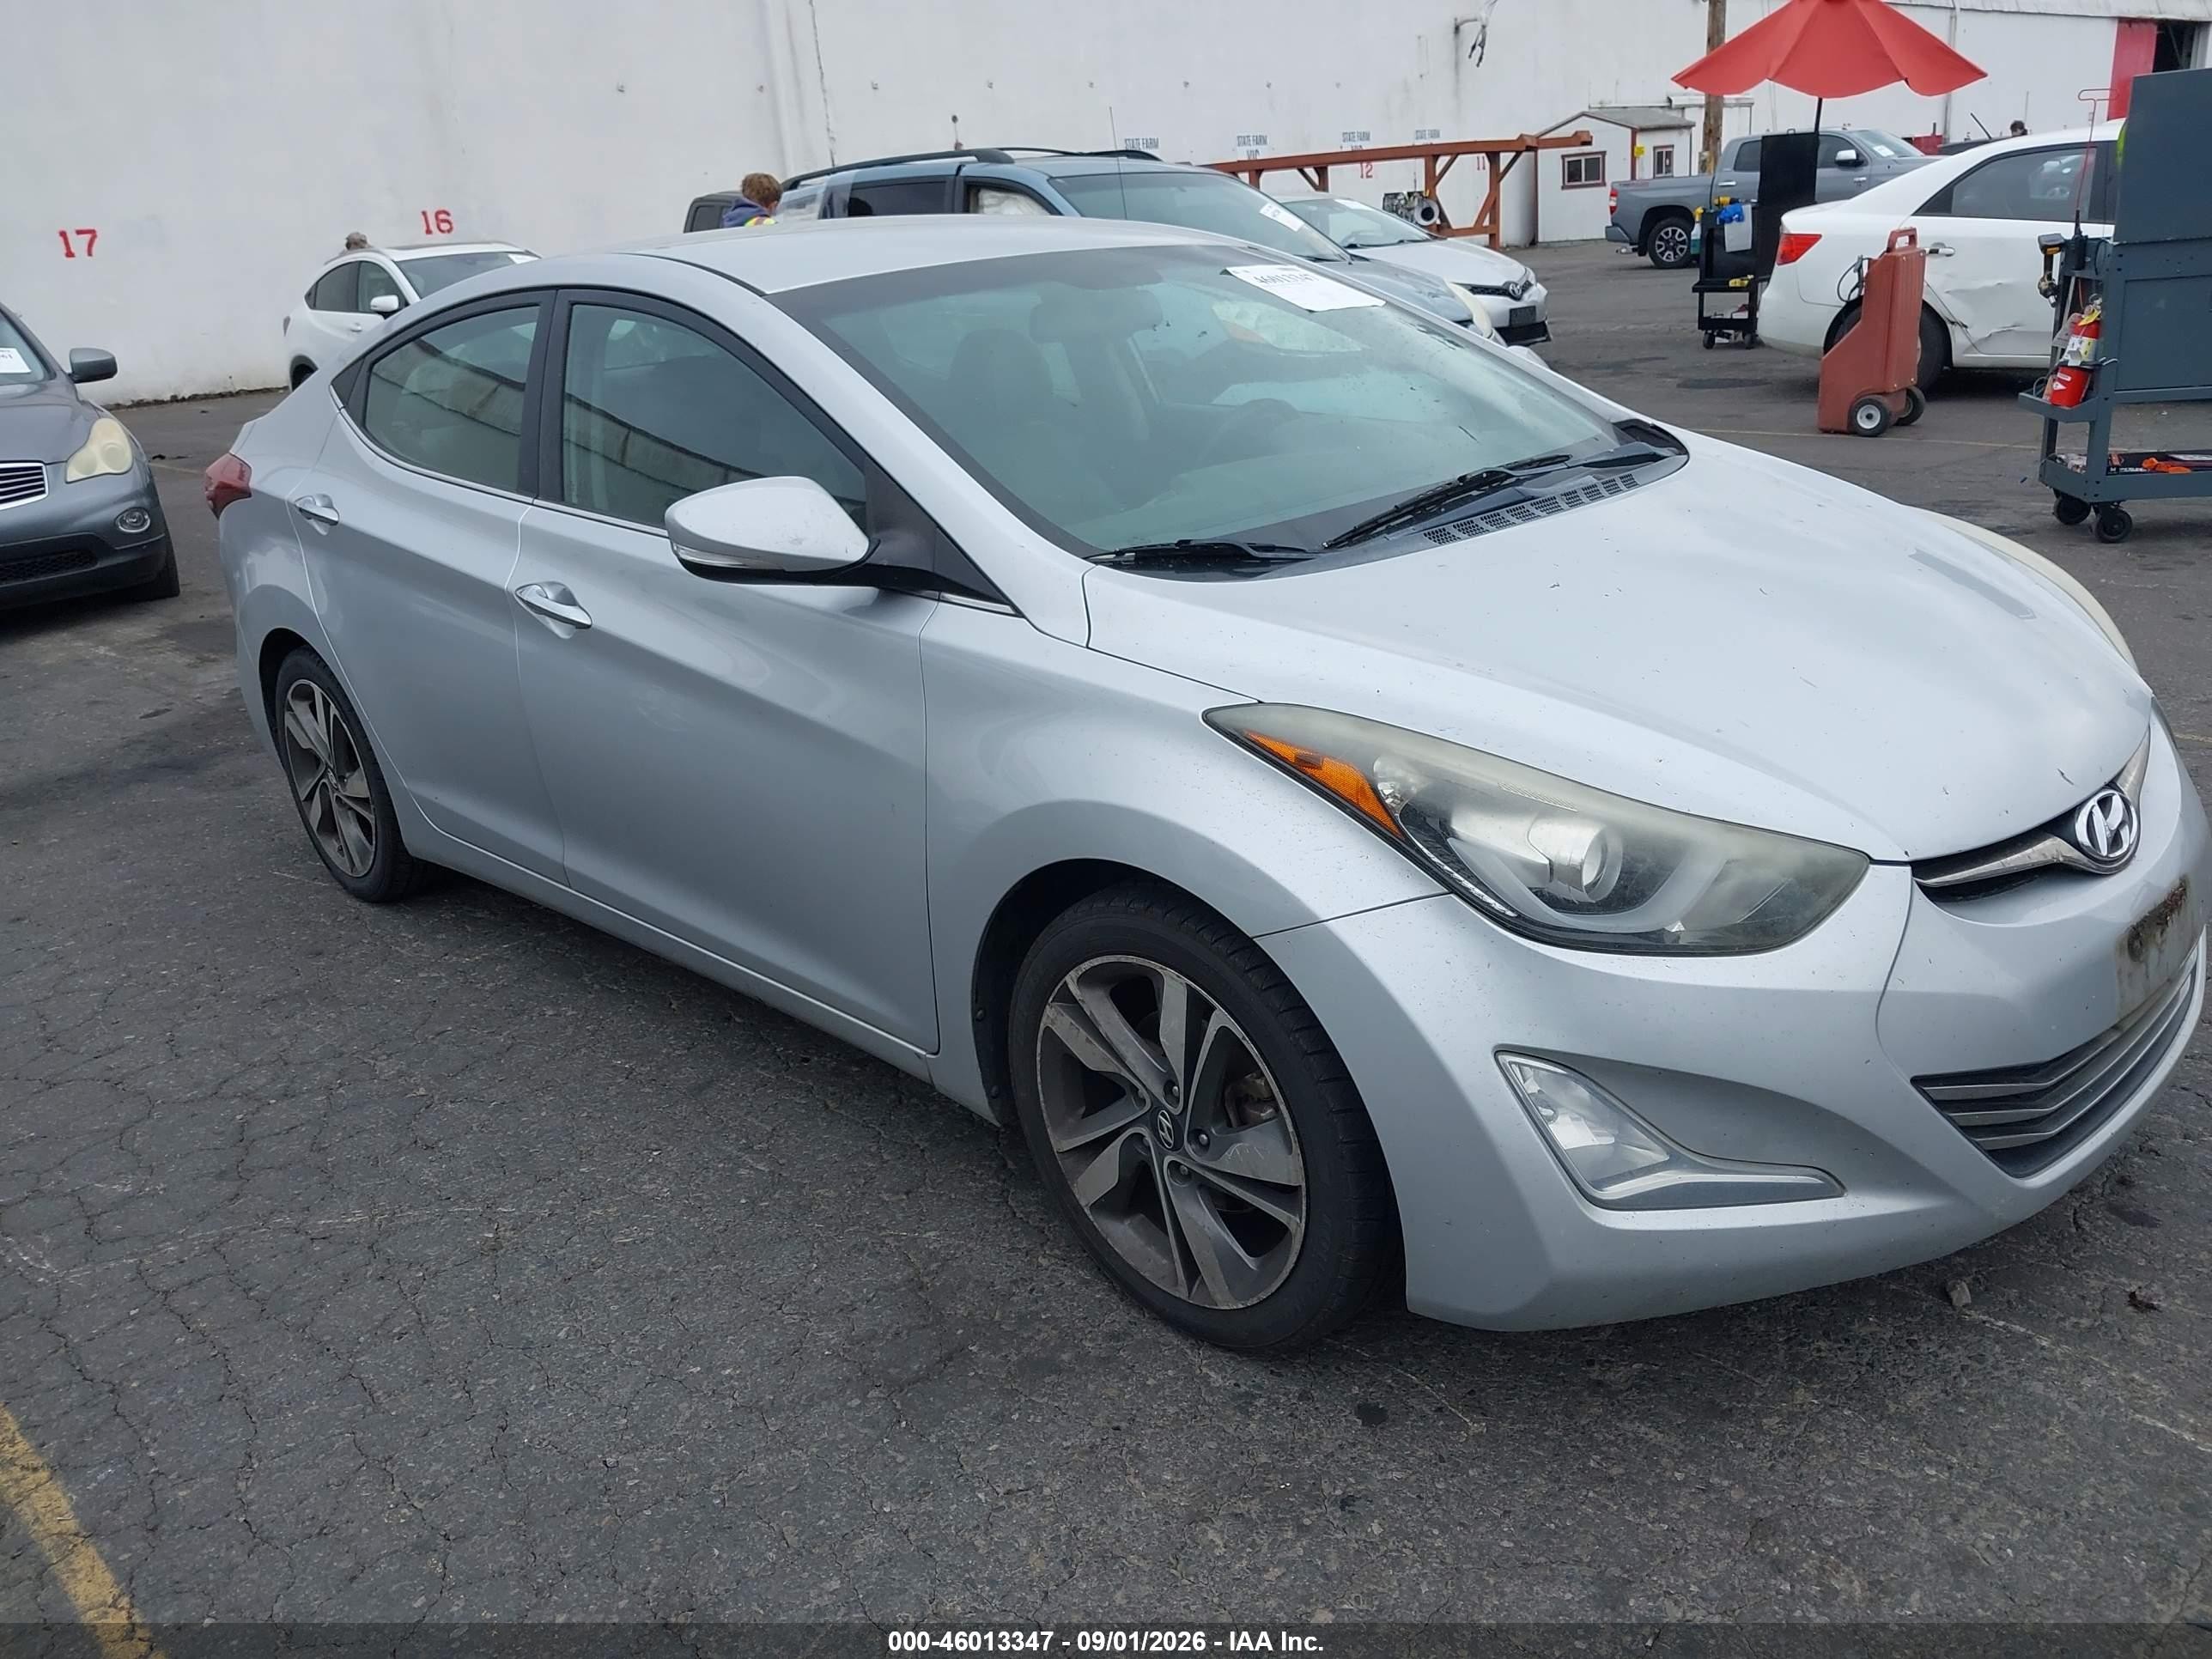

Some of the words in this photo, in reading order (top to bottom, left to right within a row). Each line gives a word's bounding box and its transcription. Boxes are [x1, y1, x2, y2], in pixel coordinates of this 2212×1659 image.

[1124, 138, 1140, 150] STATE
[1142, 137, 1159, 149] FARM
[1237, 136, 1251, 147] STATE
[1252, 135, 1267, 145] FARM
[1359, 161, 1373, 179] 12
[421, 209, 453, 235] 16
[58, 228, 98, 258] 17
